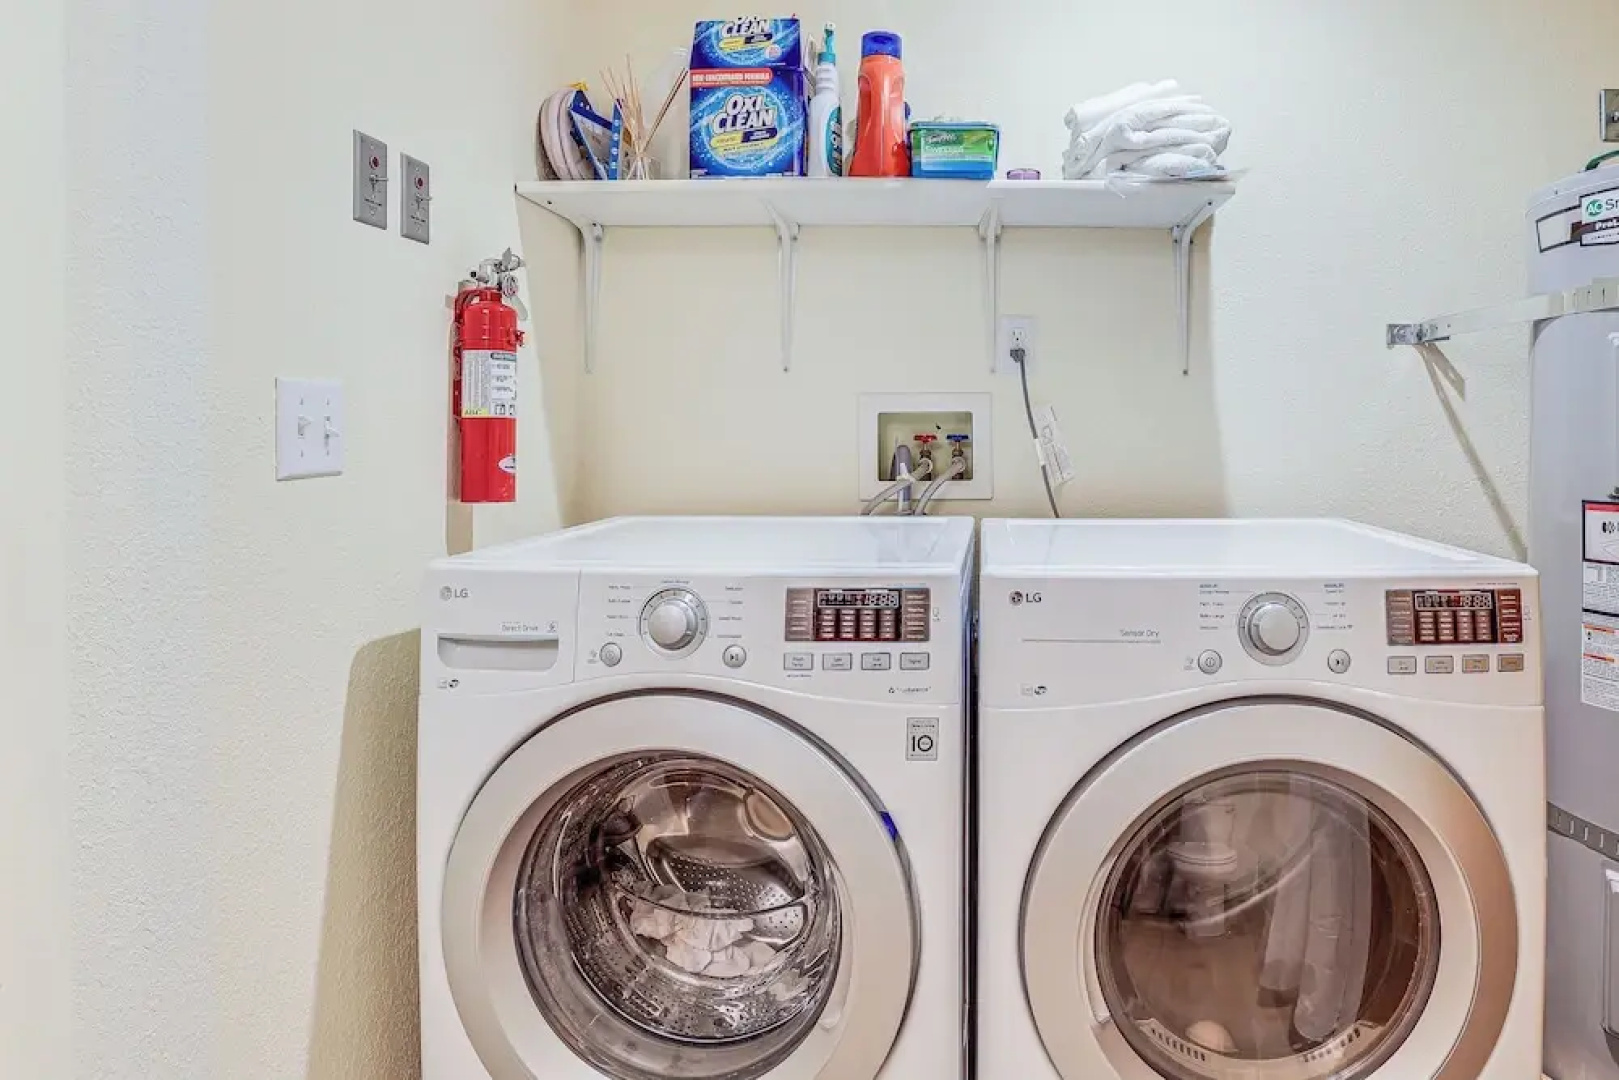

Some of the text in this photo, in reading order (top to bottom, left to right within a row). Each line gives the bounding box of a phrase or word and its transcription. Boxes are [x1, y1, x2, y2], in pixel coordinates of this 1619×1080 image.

[720, 18, 770, 39] CLEAN
[725, 94, 764, 115] OXI
[713, 108, 775, 133] CLEAN
[454, 587, 469, 599] LG
[1026, 592, 1042, 603] LG
[501, 624, 539, 632] Direct Drive
[1120, 629, 1159, 638] Sensor Dry
